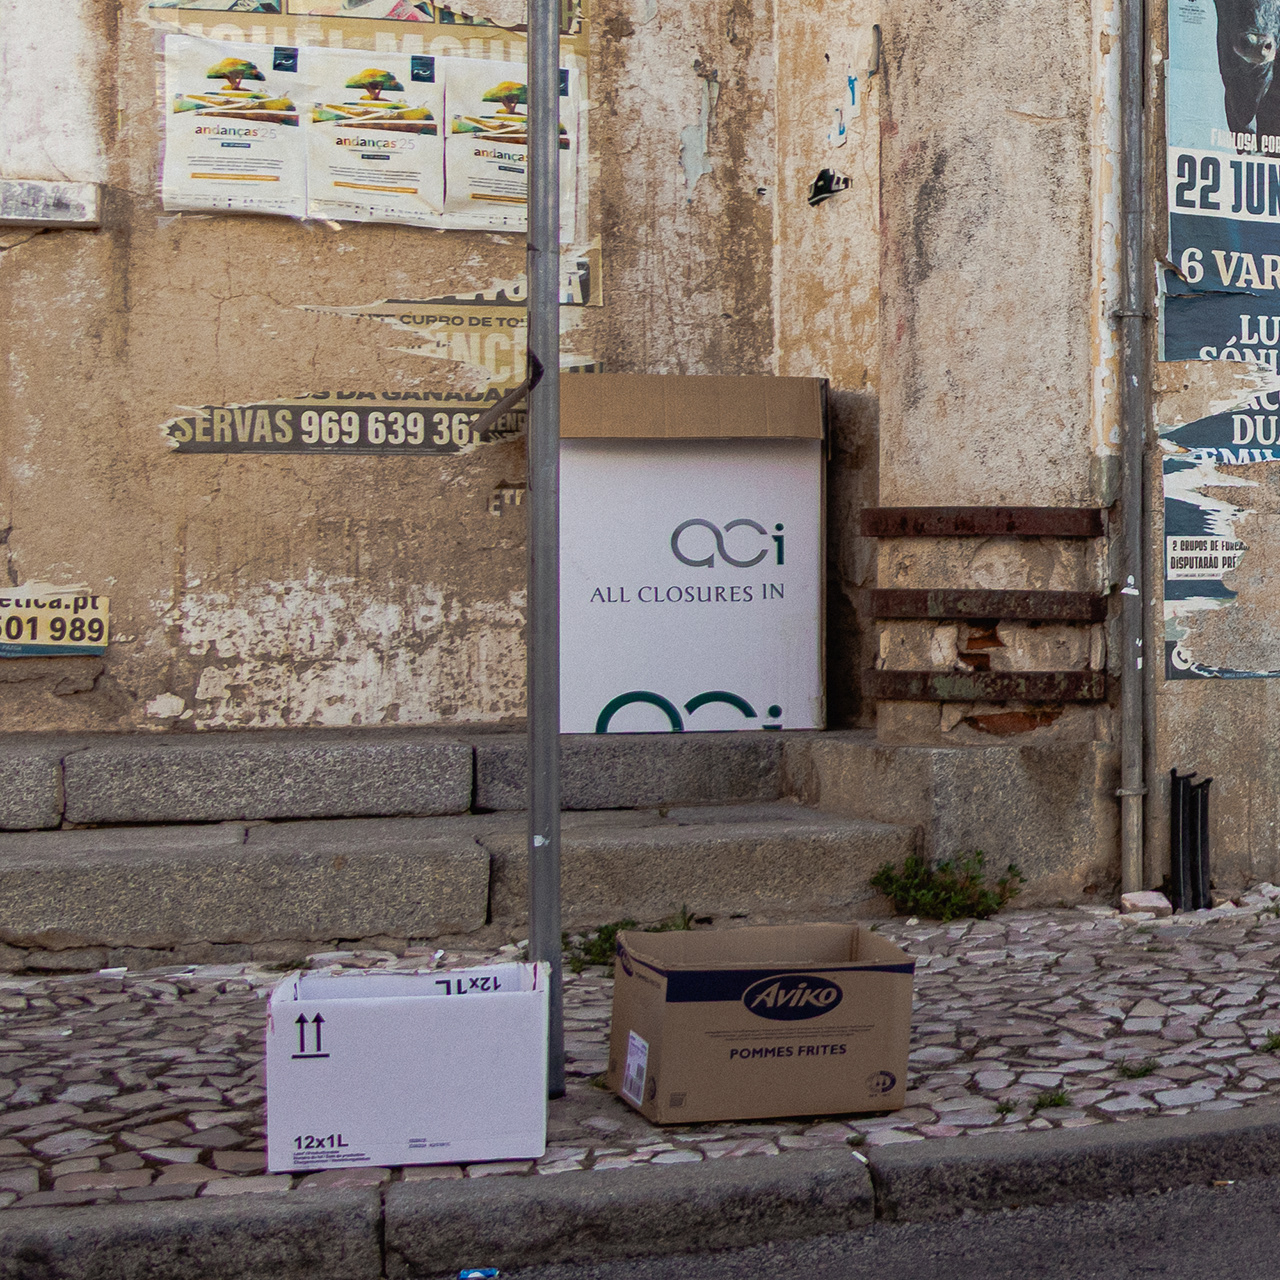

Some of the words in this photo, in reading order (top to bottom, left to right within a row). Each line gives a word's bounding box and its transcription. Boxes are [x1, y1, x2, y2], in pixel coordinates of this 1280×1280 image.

[1175, 154, 1221, 210] 22
[1180, 246, 1204, 284] 6
[468, 316, 494, 327] DE
[301, 410, 359, 444] 969
[367, 411, 425, 445] 639
[1173, 540, 1178, 551] 2
[1210, 540, 1218, 551] DE
[590, 587, 630, 603] ALL
[638, 586, 753, 603] CLOSURES
[762, 583, 785, 601] IN
[0, 616, 38, 640] 01
[50, 616, 104, 642] 989
[730, 1046, 793, 1060] POMMES
[798, 1043, 847, 1056] FRITES
[294, 1134, 349, 1150] 12x1L
